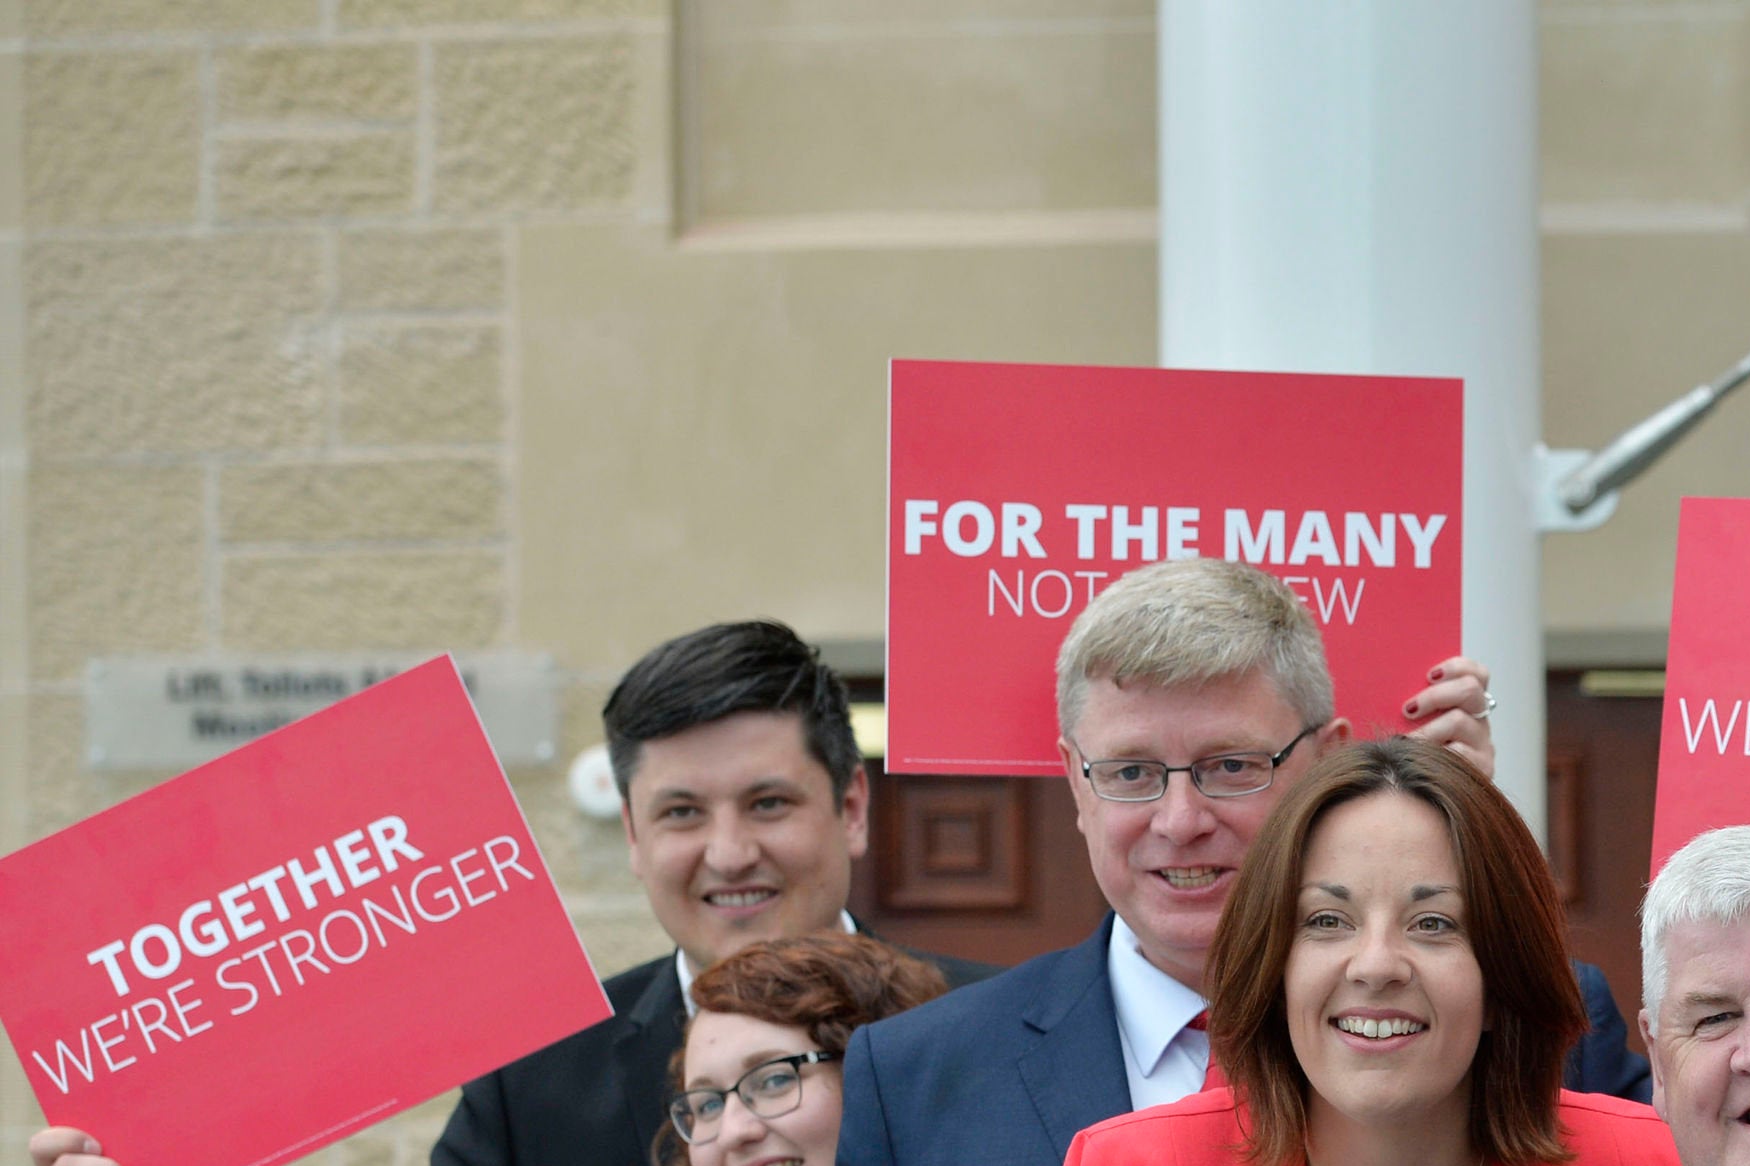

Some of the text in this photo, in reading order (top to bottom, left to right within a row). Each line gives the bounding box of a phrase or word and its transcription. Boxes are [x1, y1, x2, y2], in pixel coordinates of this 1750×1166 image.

[904, 499, 1447, 568] FOR THE MANY
[32, 833, 535, 1095] WE'RE STRONGER
[87, 814, 425, 998] TOGETHER
